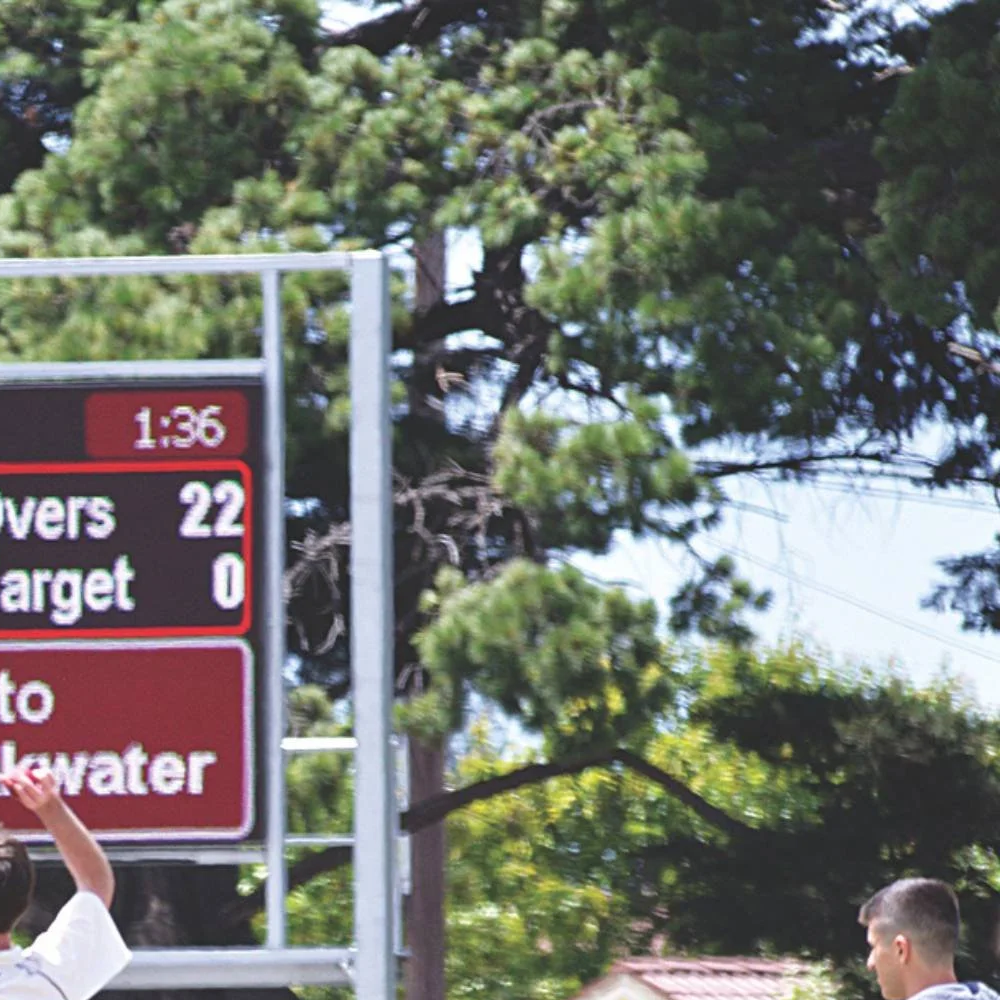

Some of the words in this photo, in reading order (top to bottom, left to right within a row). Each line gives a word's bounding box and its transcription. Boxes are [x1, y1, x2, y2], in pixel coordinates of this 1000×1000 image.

[134, 407, 227, 451] 1:36
[178, 481, 245, 538] 22
[212, 554, 245, 609] 0
